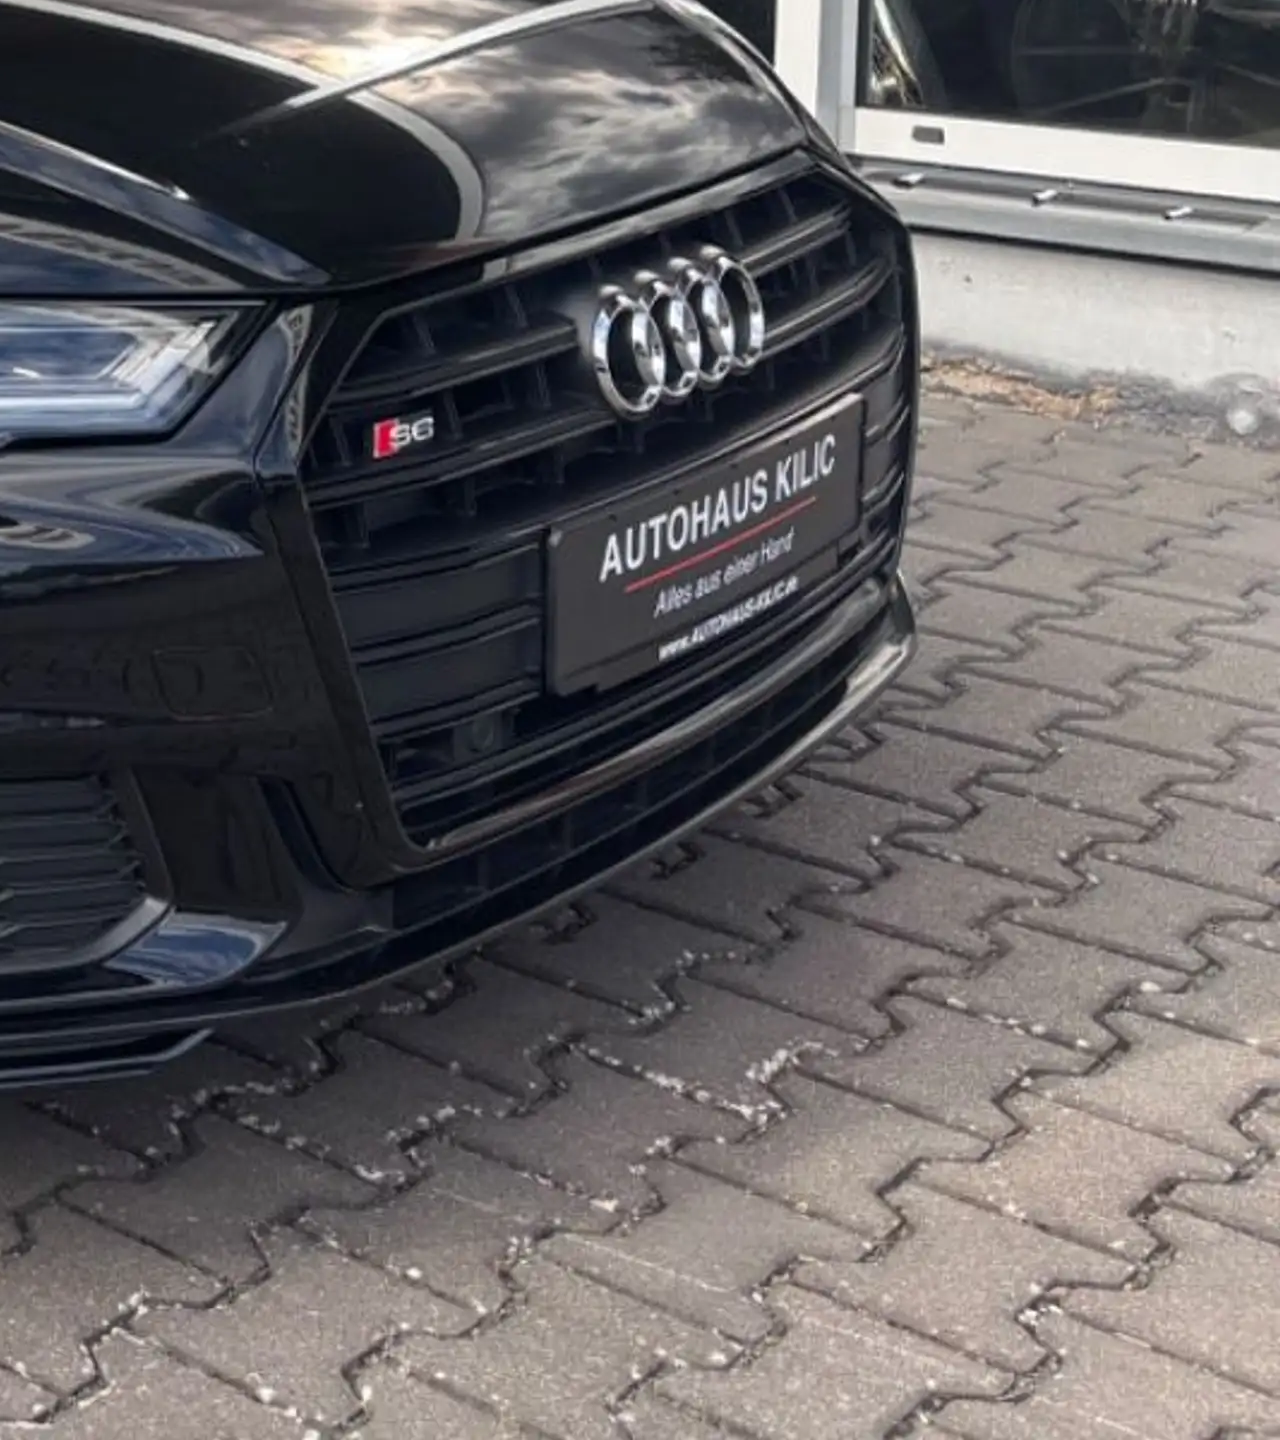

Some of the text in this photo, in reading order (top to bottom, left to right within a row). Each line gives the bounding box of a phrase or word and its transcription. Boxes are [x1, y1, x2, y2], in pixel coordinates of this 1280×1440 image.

[385, 416, 434, 449] S6
[599, 433, 835, 582] AUTOHAUS KILIC
[654, 525, 794, 618] Alles aus einer Hand
